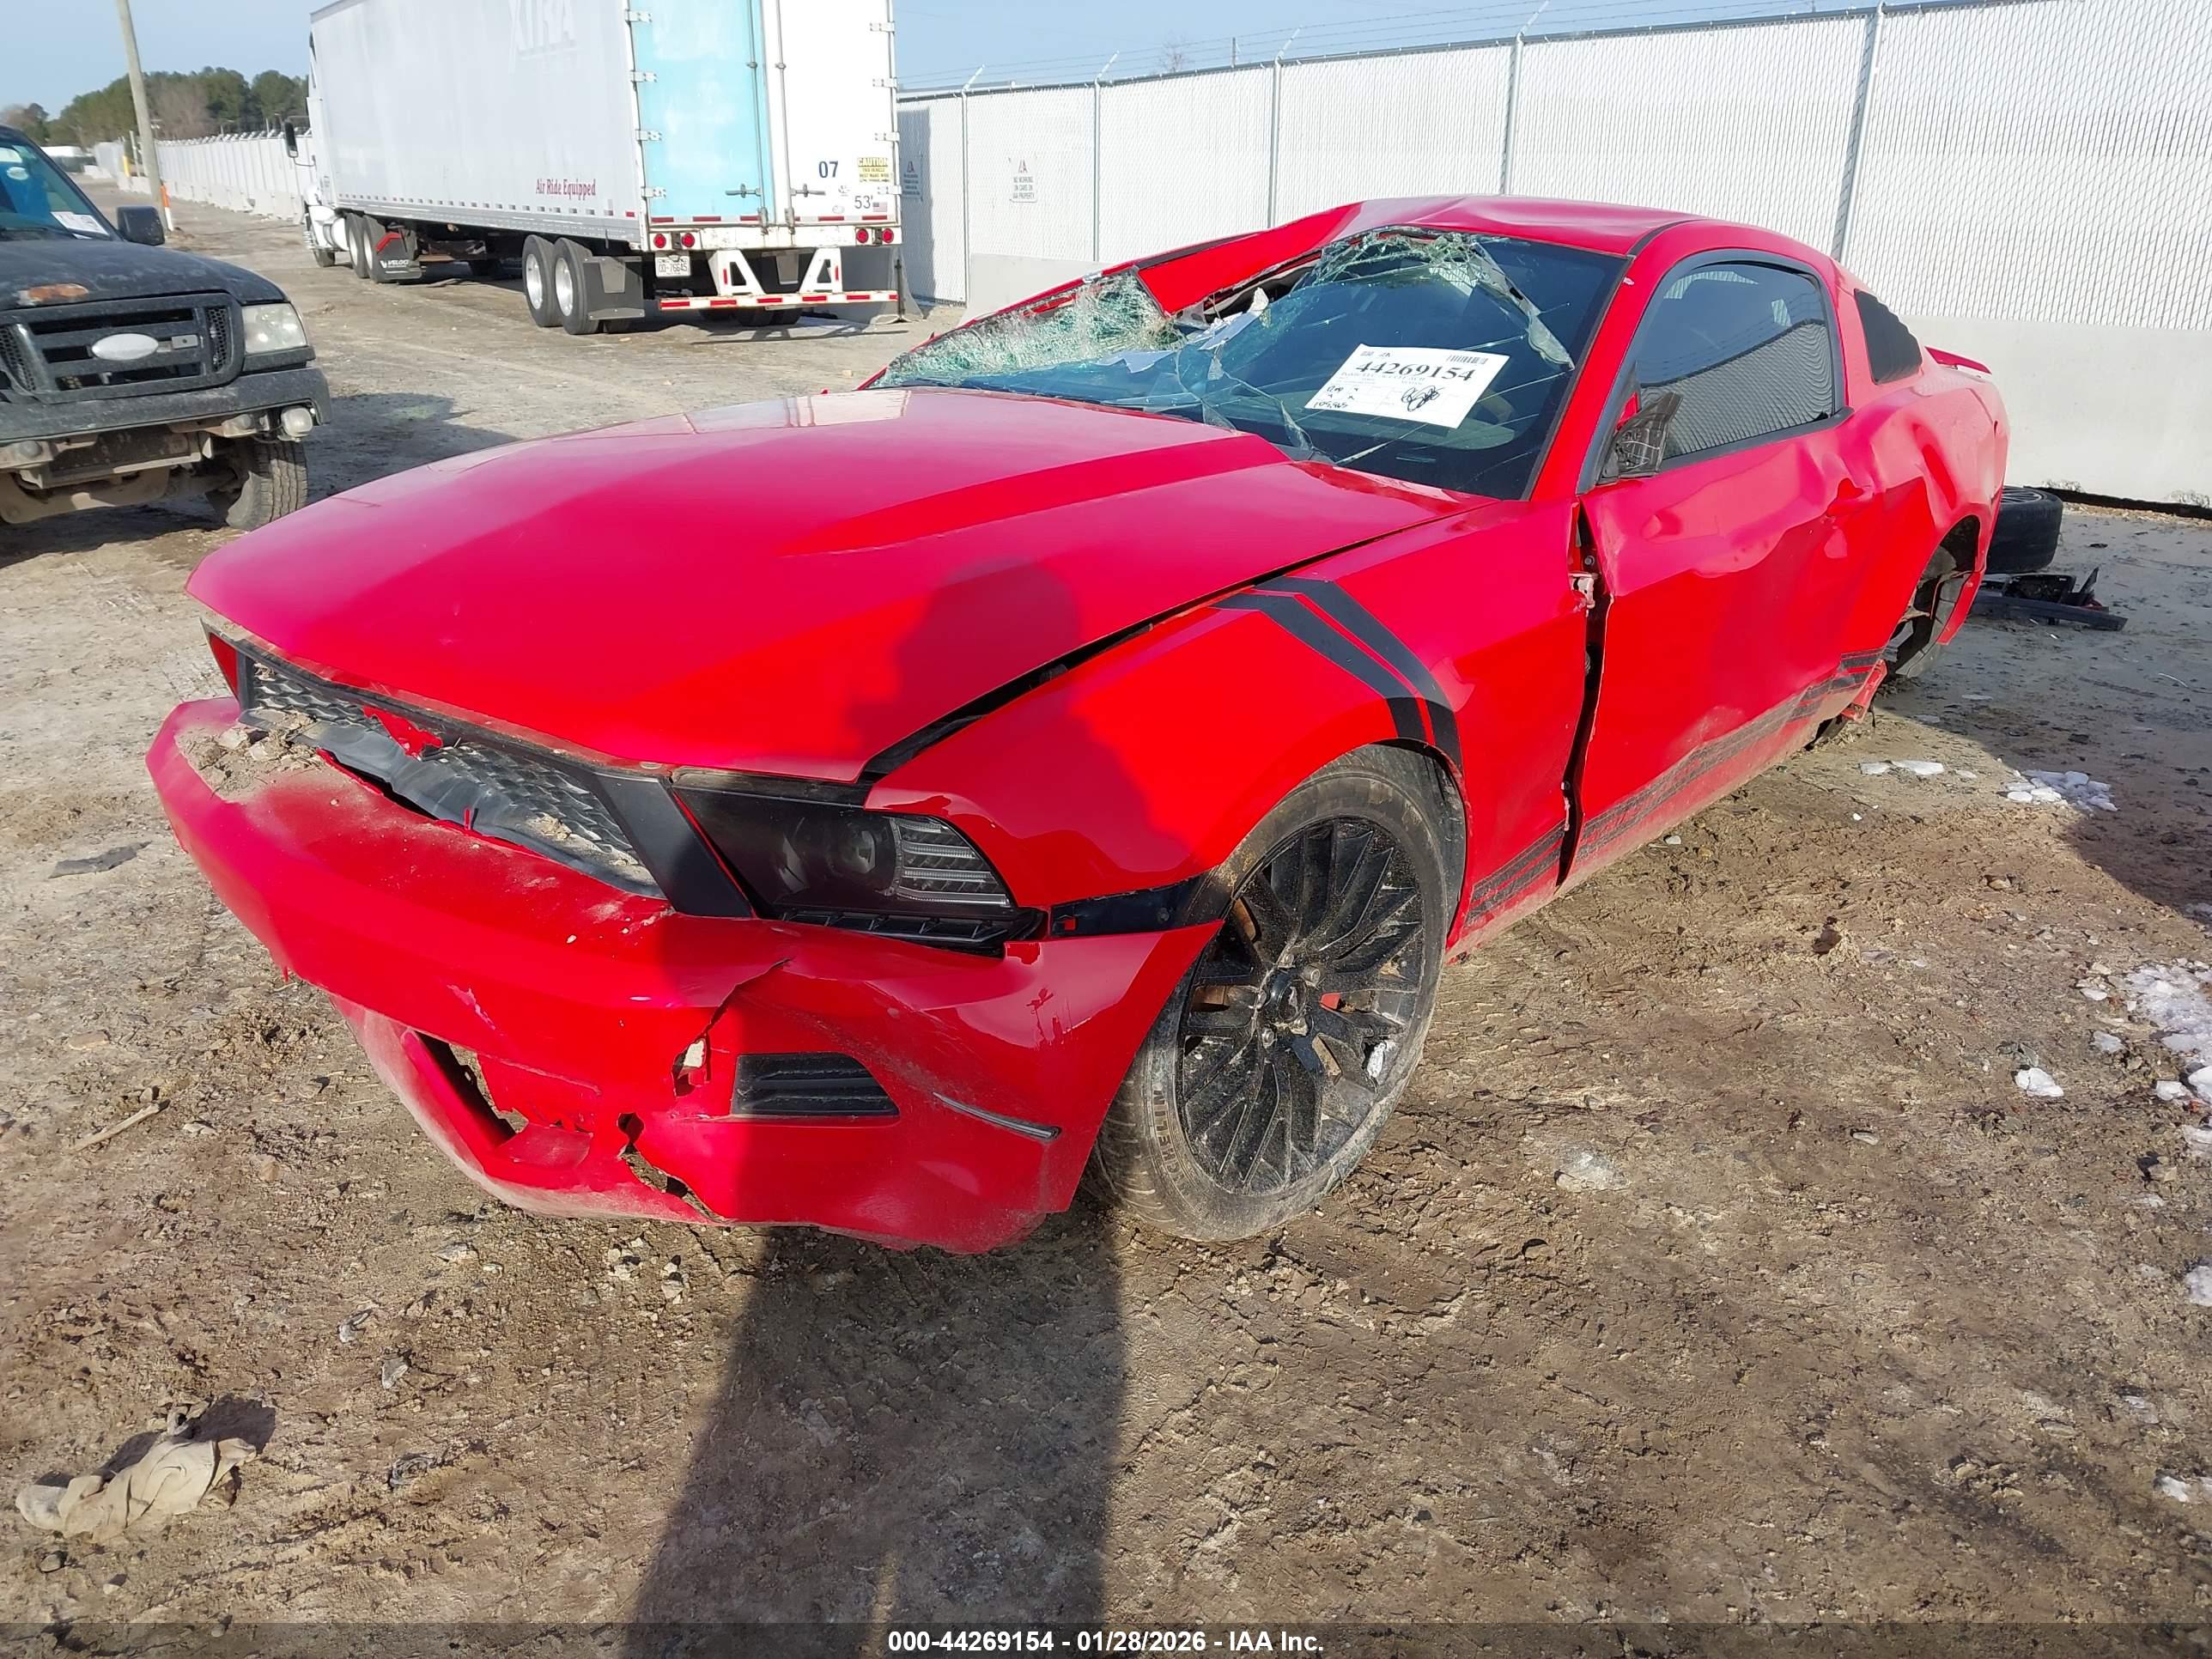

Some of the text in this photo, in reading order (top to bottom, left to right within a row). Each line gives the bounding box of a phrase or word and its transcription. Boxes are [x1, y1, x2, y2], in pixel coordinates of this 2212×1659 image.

[818, 161, 838, 178] 07
[858, 157, 888, 167] CAUTION
[536, 179, 596, 201] Air Ride Equipped
[1356, 361, 1476, 381] 44269154
